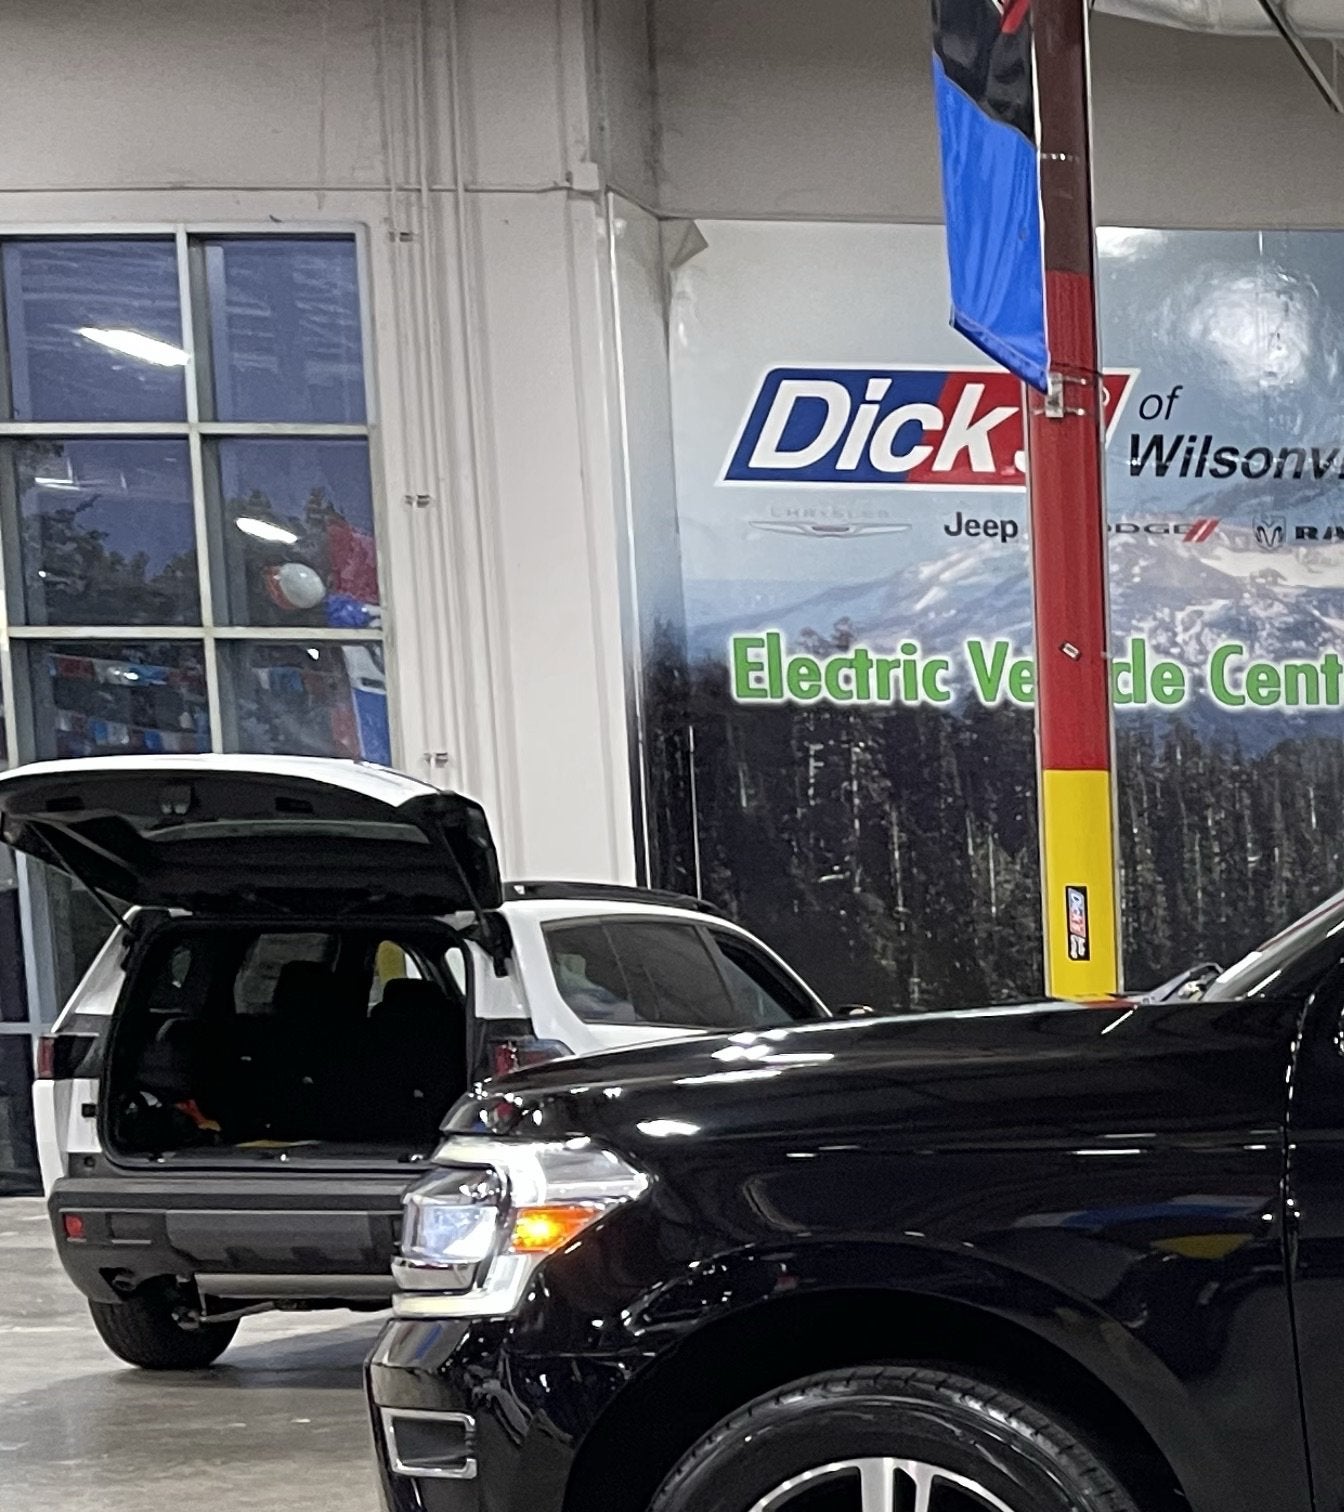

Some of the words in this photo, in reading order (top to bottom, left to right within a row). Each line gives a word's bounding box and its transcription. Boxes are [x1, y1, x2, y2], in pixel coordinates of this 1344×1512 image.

[748, 377, 1029, 474] Dick
[1138, 385, 1183, 420] of
[944, 512, 1018, 543] Jeep
[733, 632, 951, 700] Electric
[967, 638, 1185, 704] Vecle
